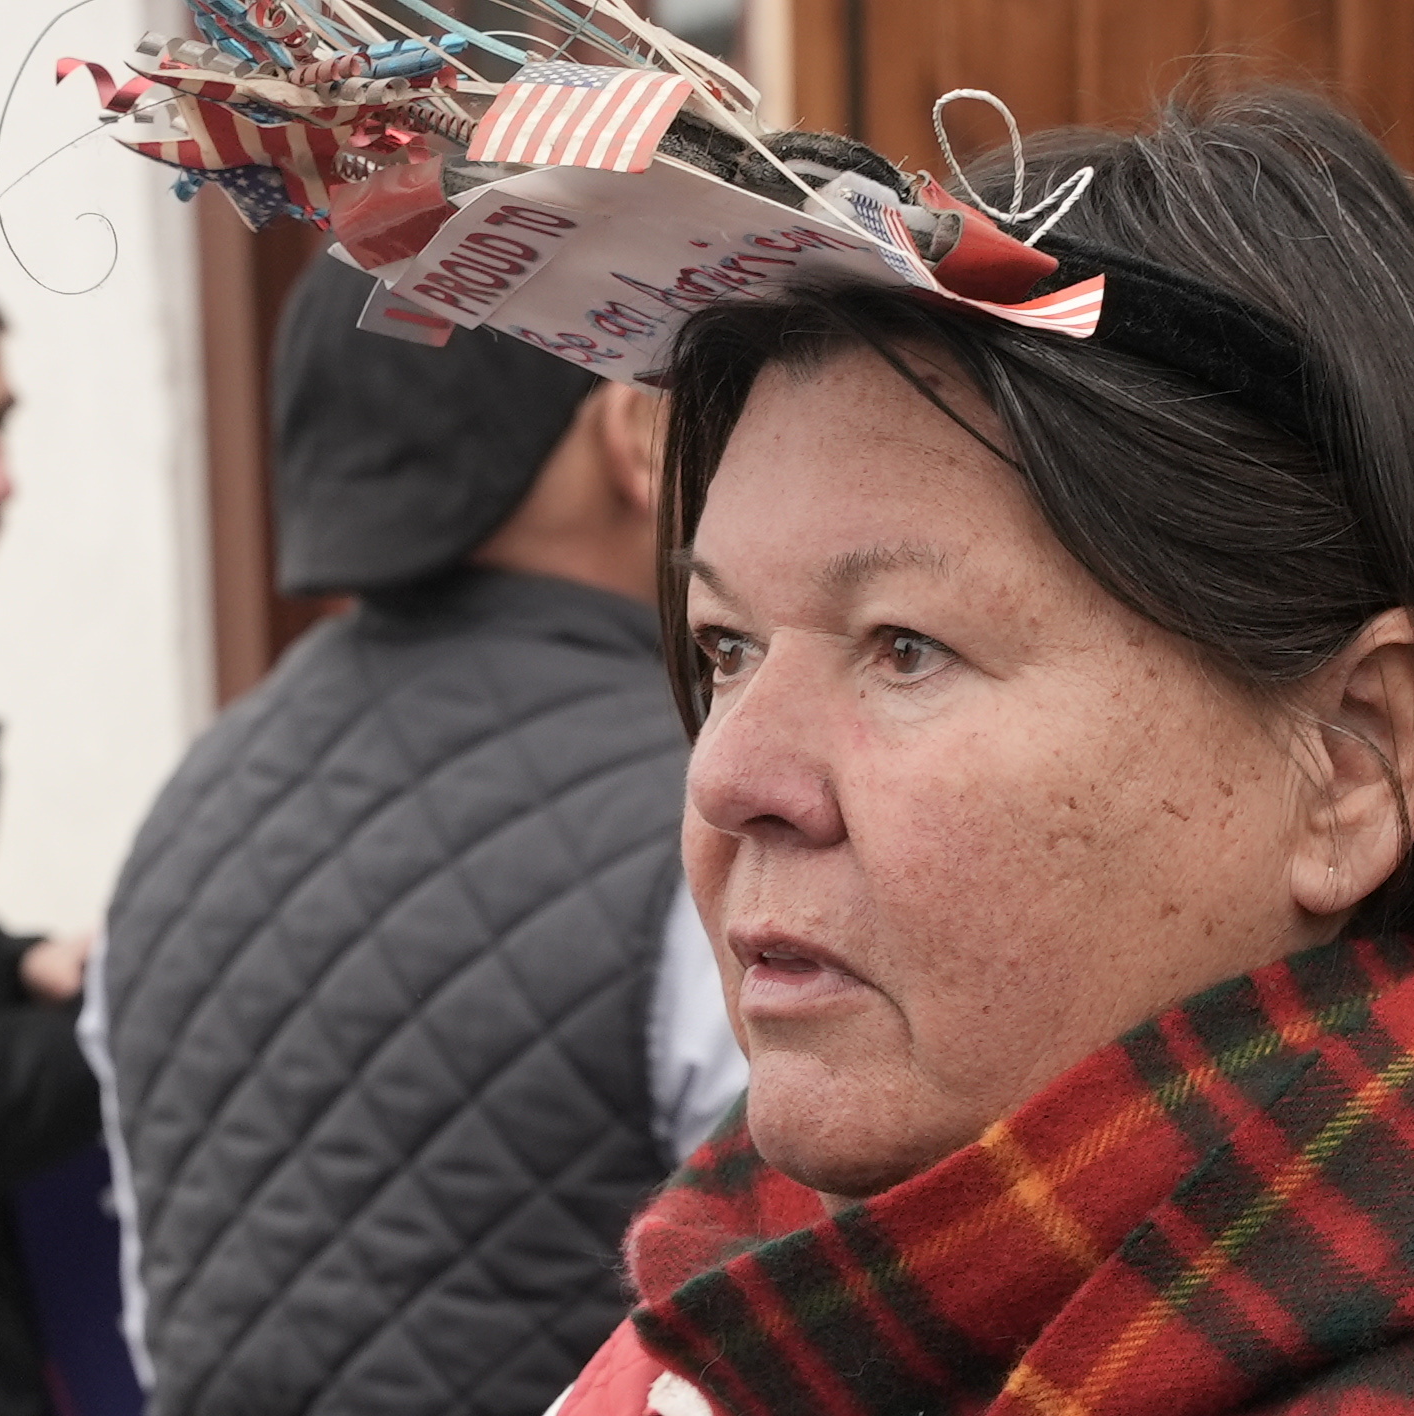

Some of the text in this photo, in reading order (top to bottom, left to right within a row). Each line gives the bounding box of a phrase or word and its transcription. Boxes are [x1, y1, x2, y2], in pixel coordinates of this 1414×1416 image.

[412, 204, 578, 317] PROUD TO
[586, 300, 666, 342] an
